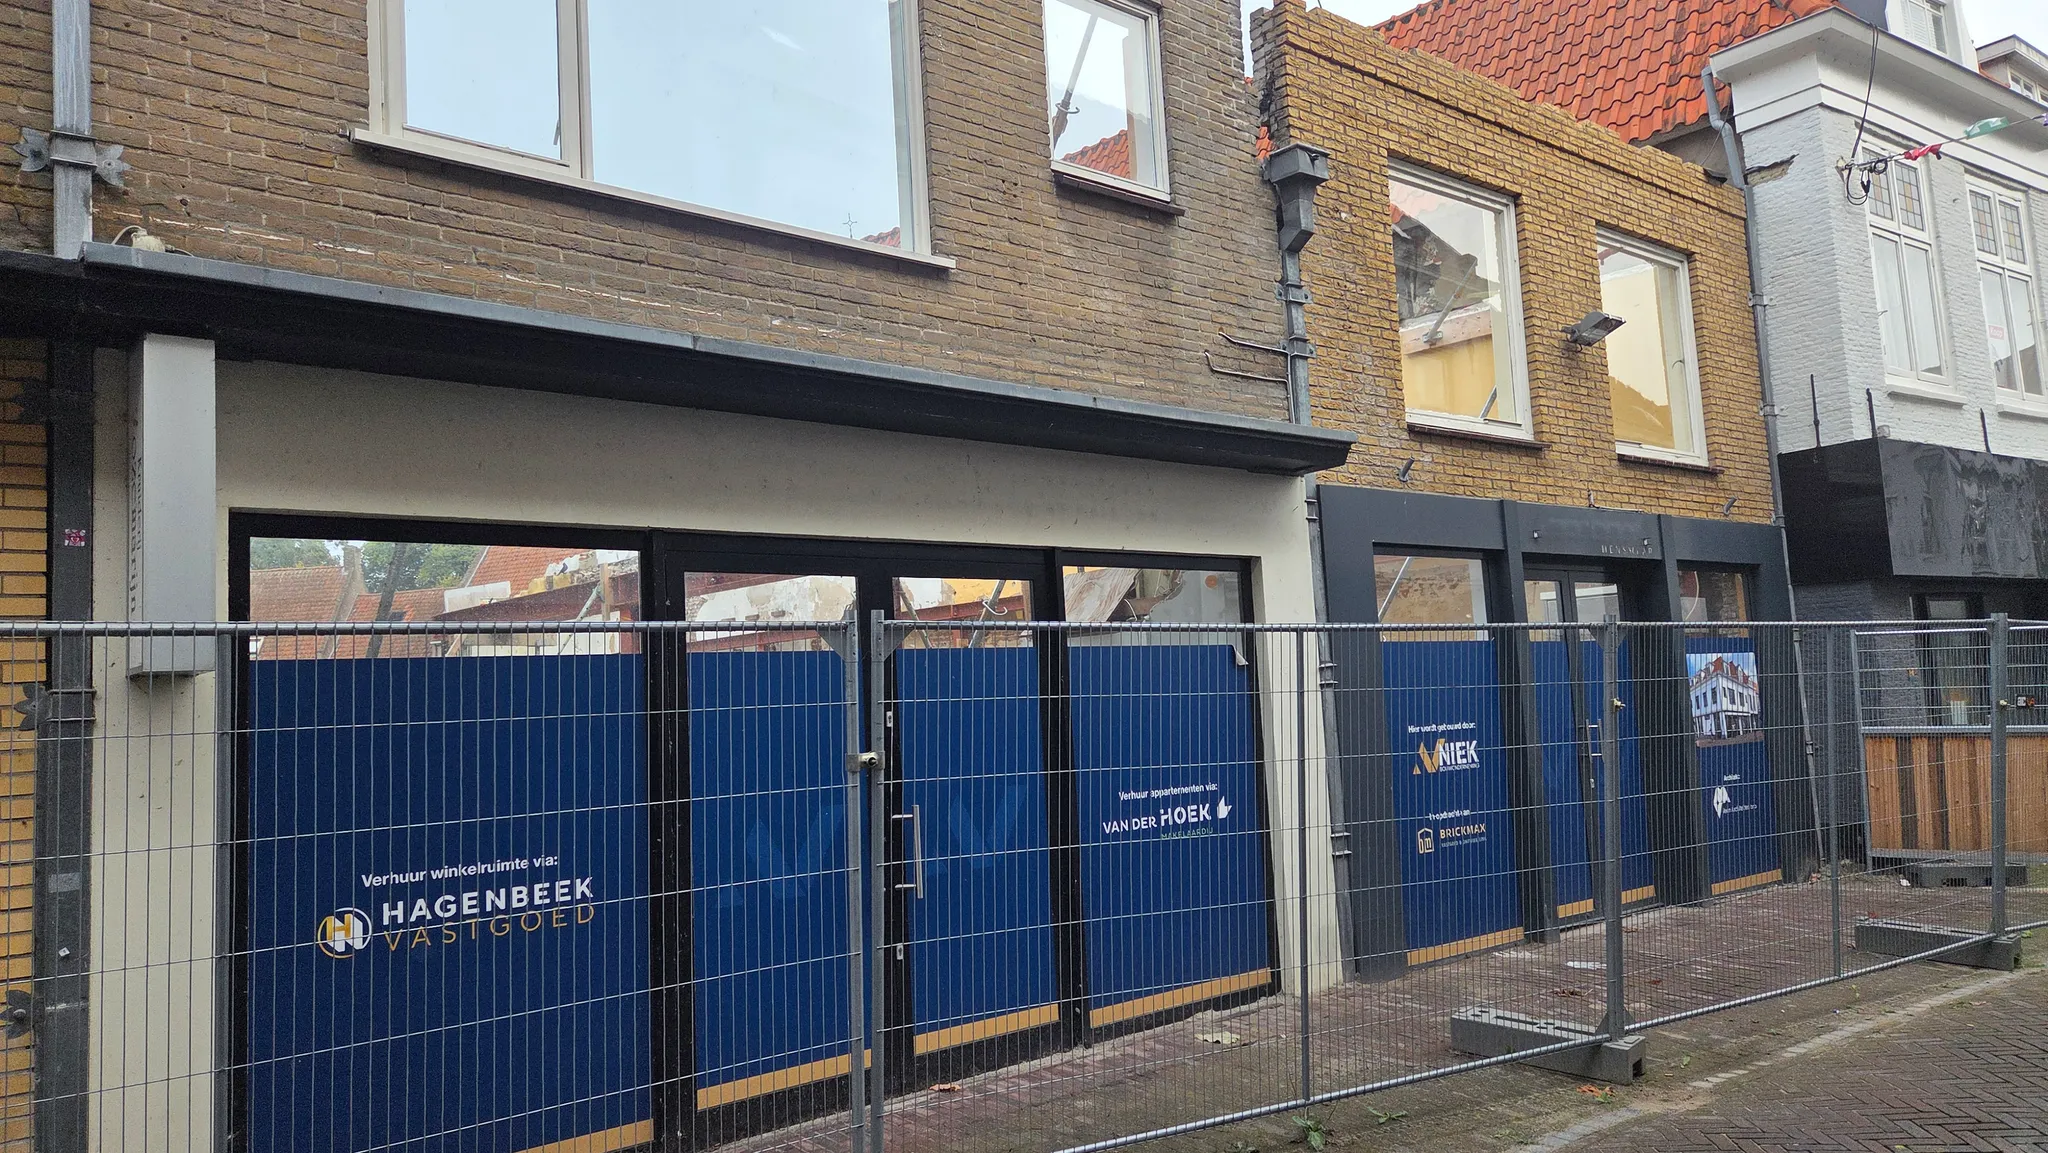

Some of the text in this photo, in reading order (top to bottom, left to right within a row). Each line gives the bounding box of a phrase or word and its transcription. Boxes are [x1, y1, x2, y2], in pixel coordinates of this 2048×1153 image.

[1438, 740, 1480, 766] NIEK
[1118, 782, 1218, 801] Verhuur appartementen via:
[1103, 803, 1212, 834] VAN DER HOEK
[1440, 823, 1487, 839] BRICKMAX
[1161, 826, 1214, 840] MAKELAARDIJ
[361, 855, 558, 888] Verhuur winkelruimte via:
[382, 876, 594, 926] HAGENBEEK
[384, 904, 595, 951] VASTGOED
